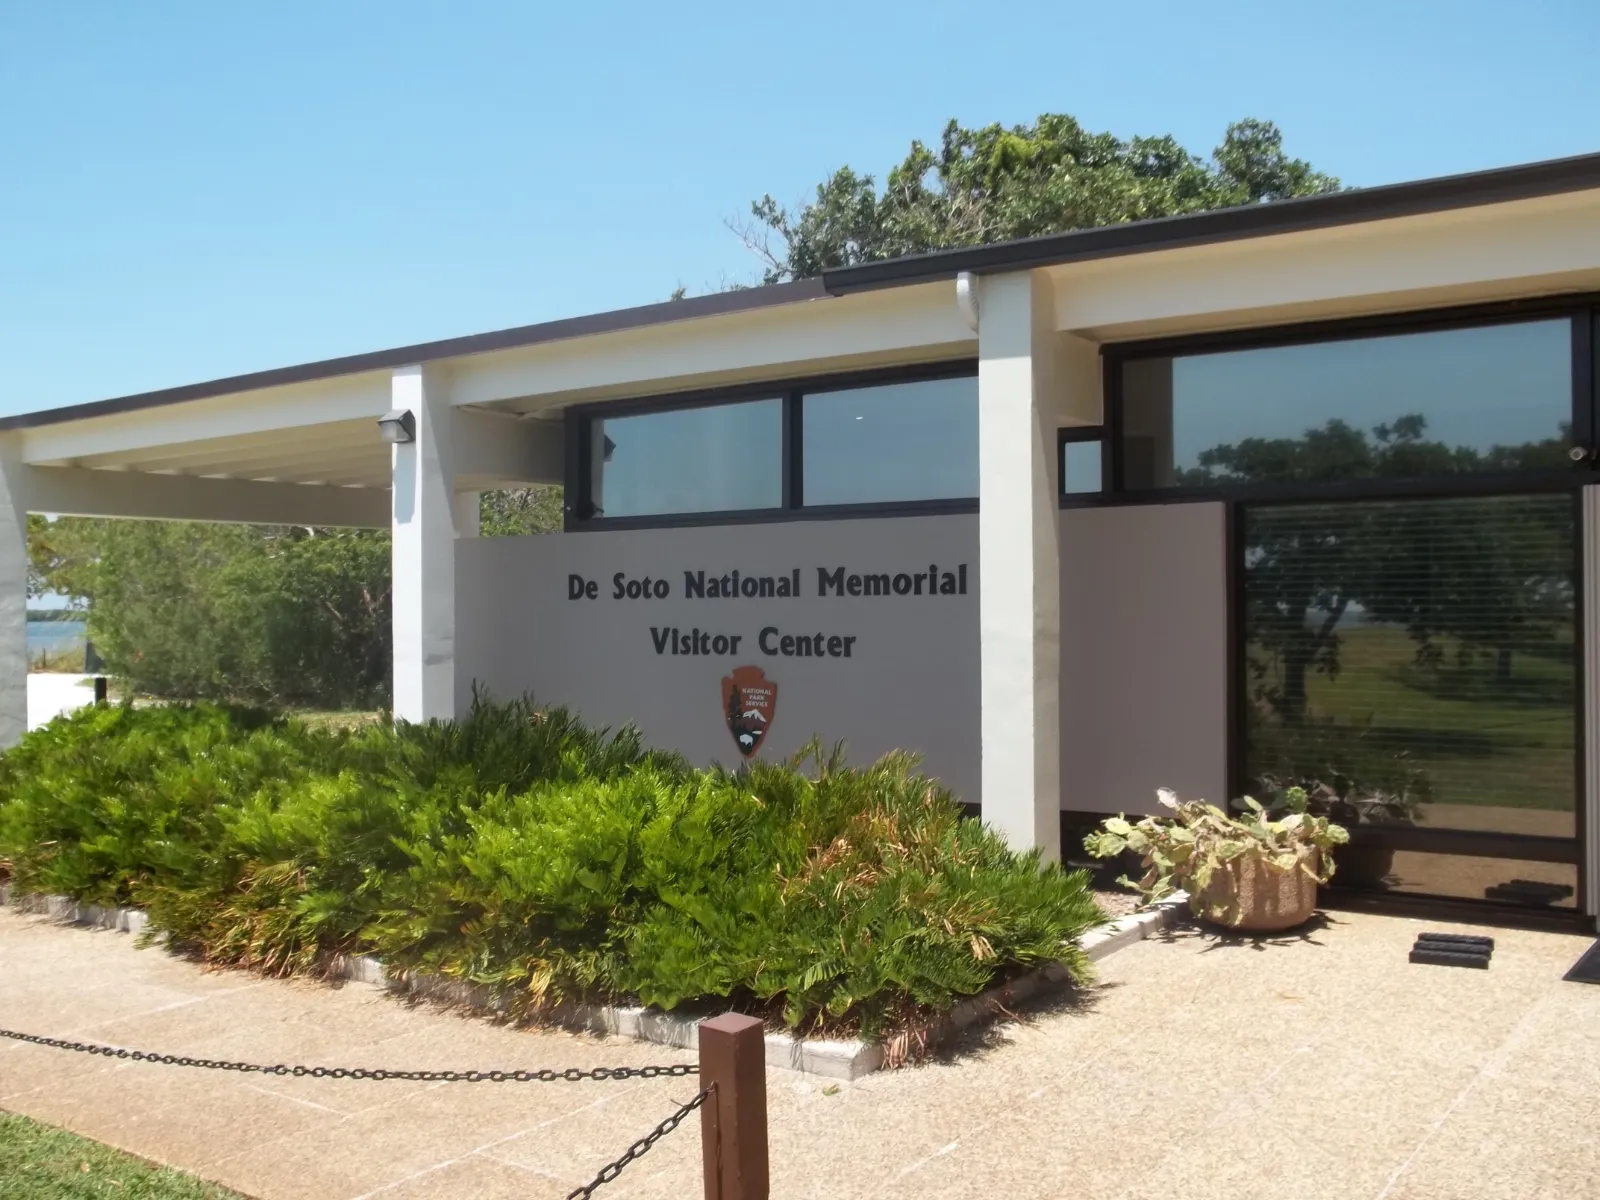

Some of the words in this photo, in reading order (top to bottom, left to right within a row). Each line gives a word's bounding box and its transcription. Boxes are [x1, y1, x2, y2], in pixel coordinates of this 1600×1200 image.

[568, 574, 598, 600] De
[613, 572, 670, 600] Soto
[684, 568, 800, 598] National
[816, 563, 968, 597] Memorial
[650, 627, 742, 655] Visitor
[758, 626, 857, 658] Center
